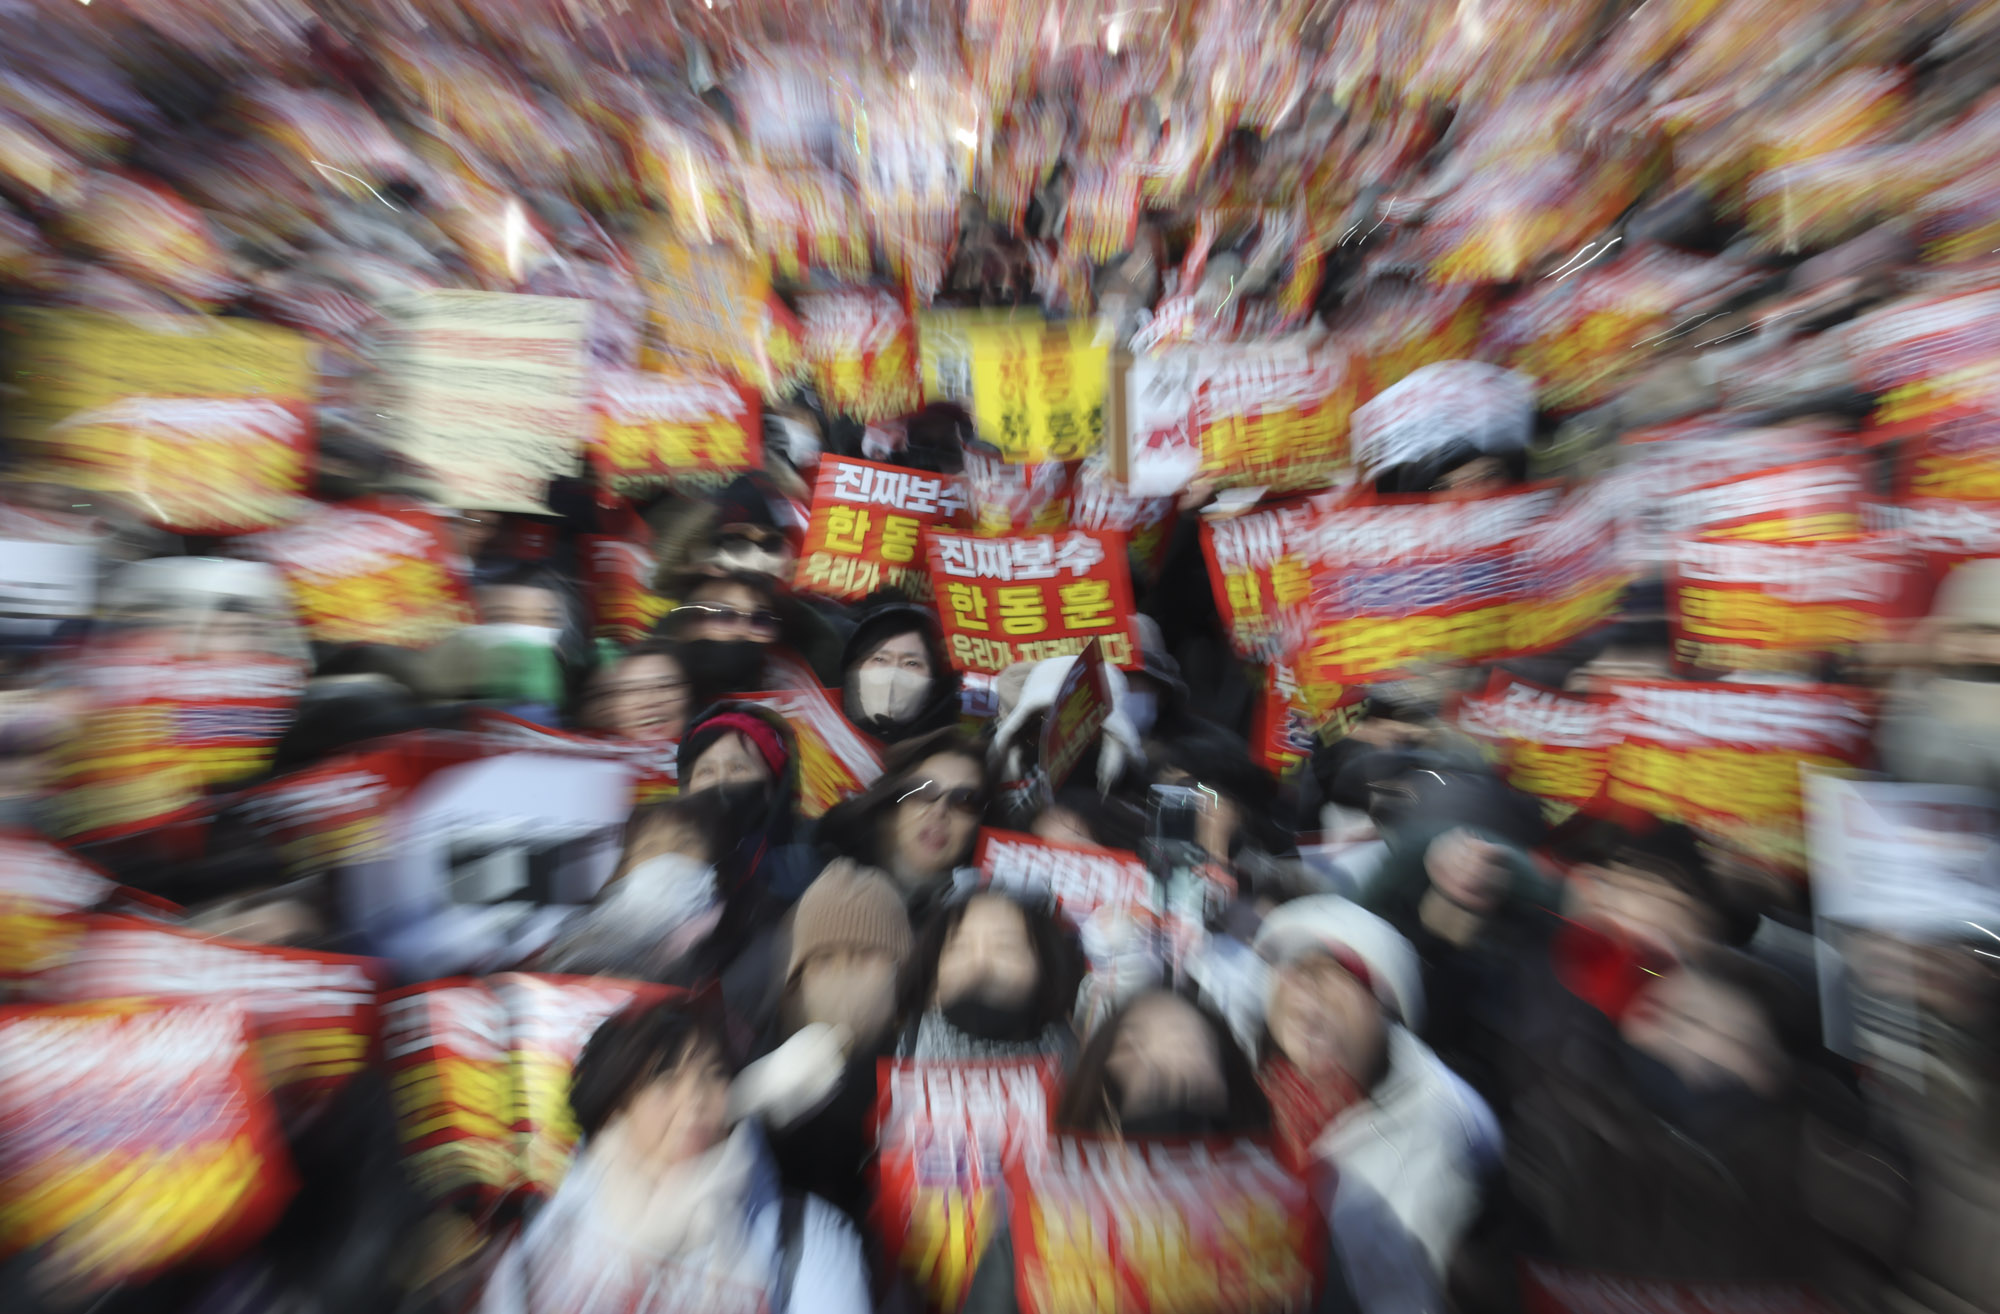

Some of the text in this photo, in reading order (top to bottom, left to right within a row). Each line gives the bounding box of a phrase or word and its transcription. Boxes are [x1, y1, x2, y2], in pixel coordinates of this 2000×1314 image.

[834, 462, 967, 517] 진짜보수
[805, 551, 880, 593] 우리가
[938, 530, 1105, 581] 진짜보수
[952, 633, 1014, 671] 우리가
